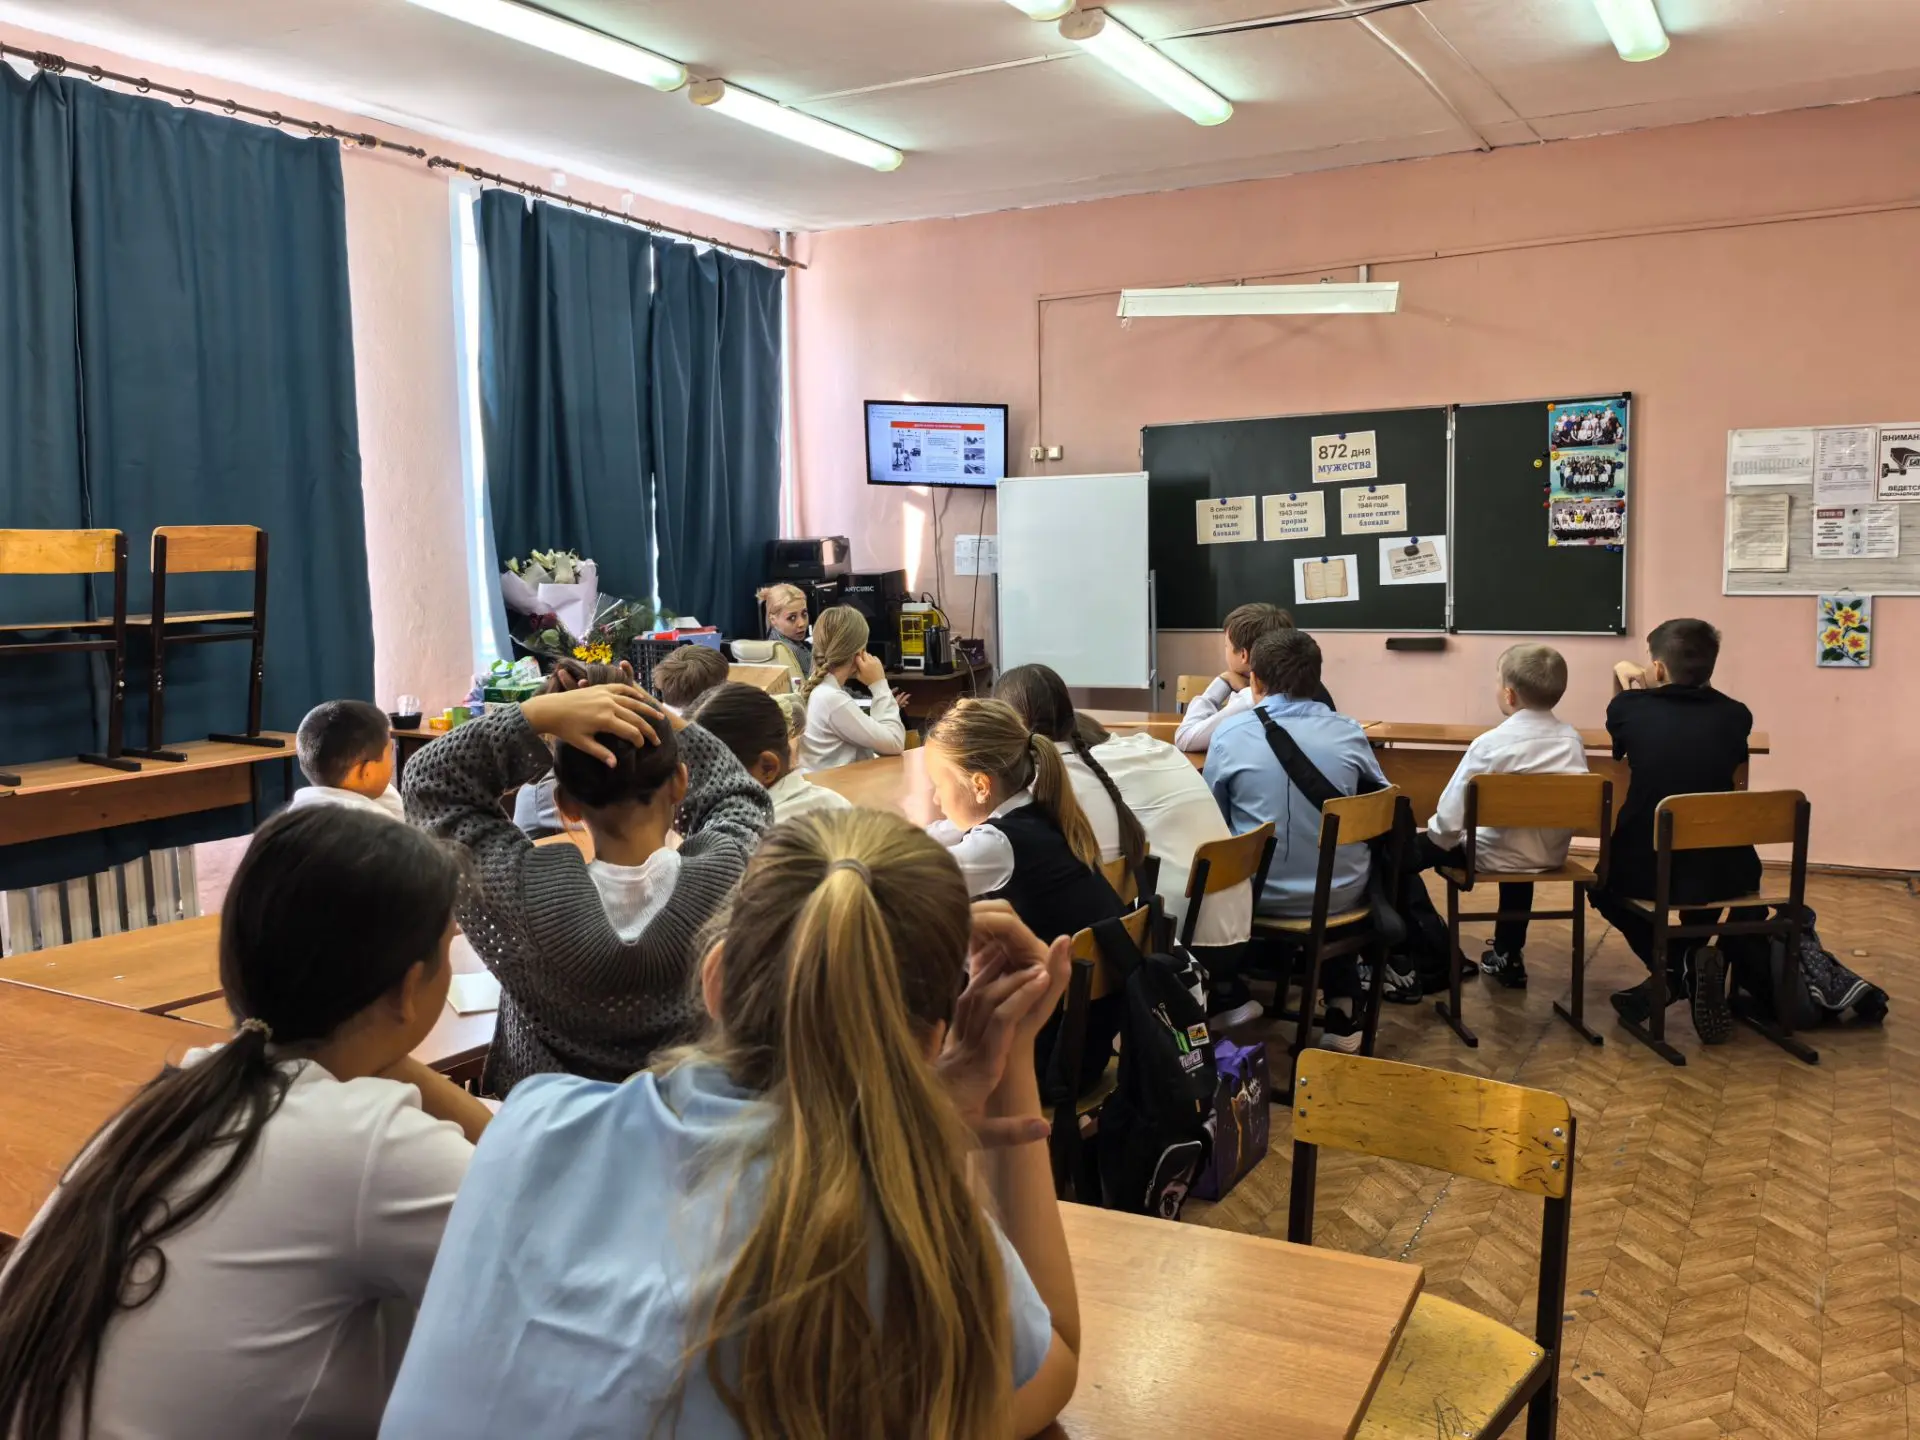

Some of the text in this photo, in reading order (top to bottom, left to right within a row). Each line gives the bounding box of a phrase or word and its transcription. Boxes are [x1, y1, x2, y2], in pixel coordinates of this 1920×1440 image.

[1318, 443, 1371, 460] 872 дня
[1317, 460, 1371, 475] мужества
[1216, 505, 1242, 513] сентября
[1281, 518, 1307, 526] прорыв
[1359, 519, 1390, 527] блокады
[1280, 526, 1309, 534] блокады
[844, 585, 875, 593] ANYCUBIC
